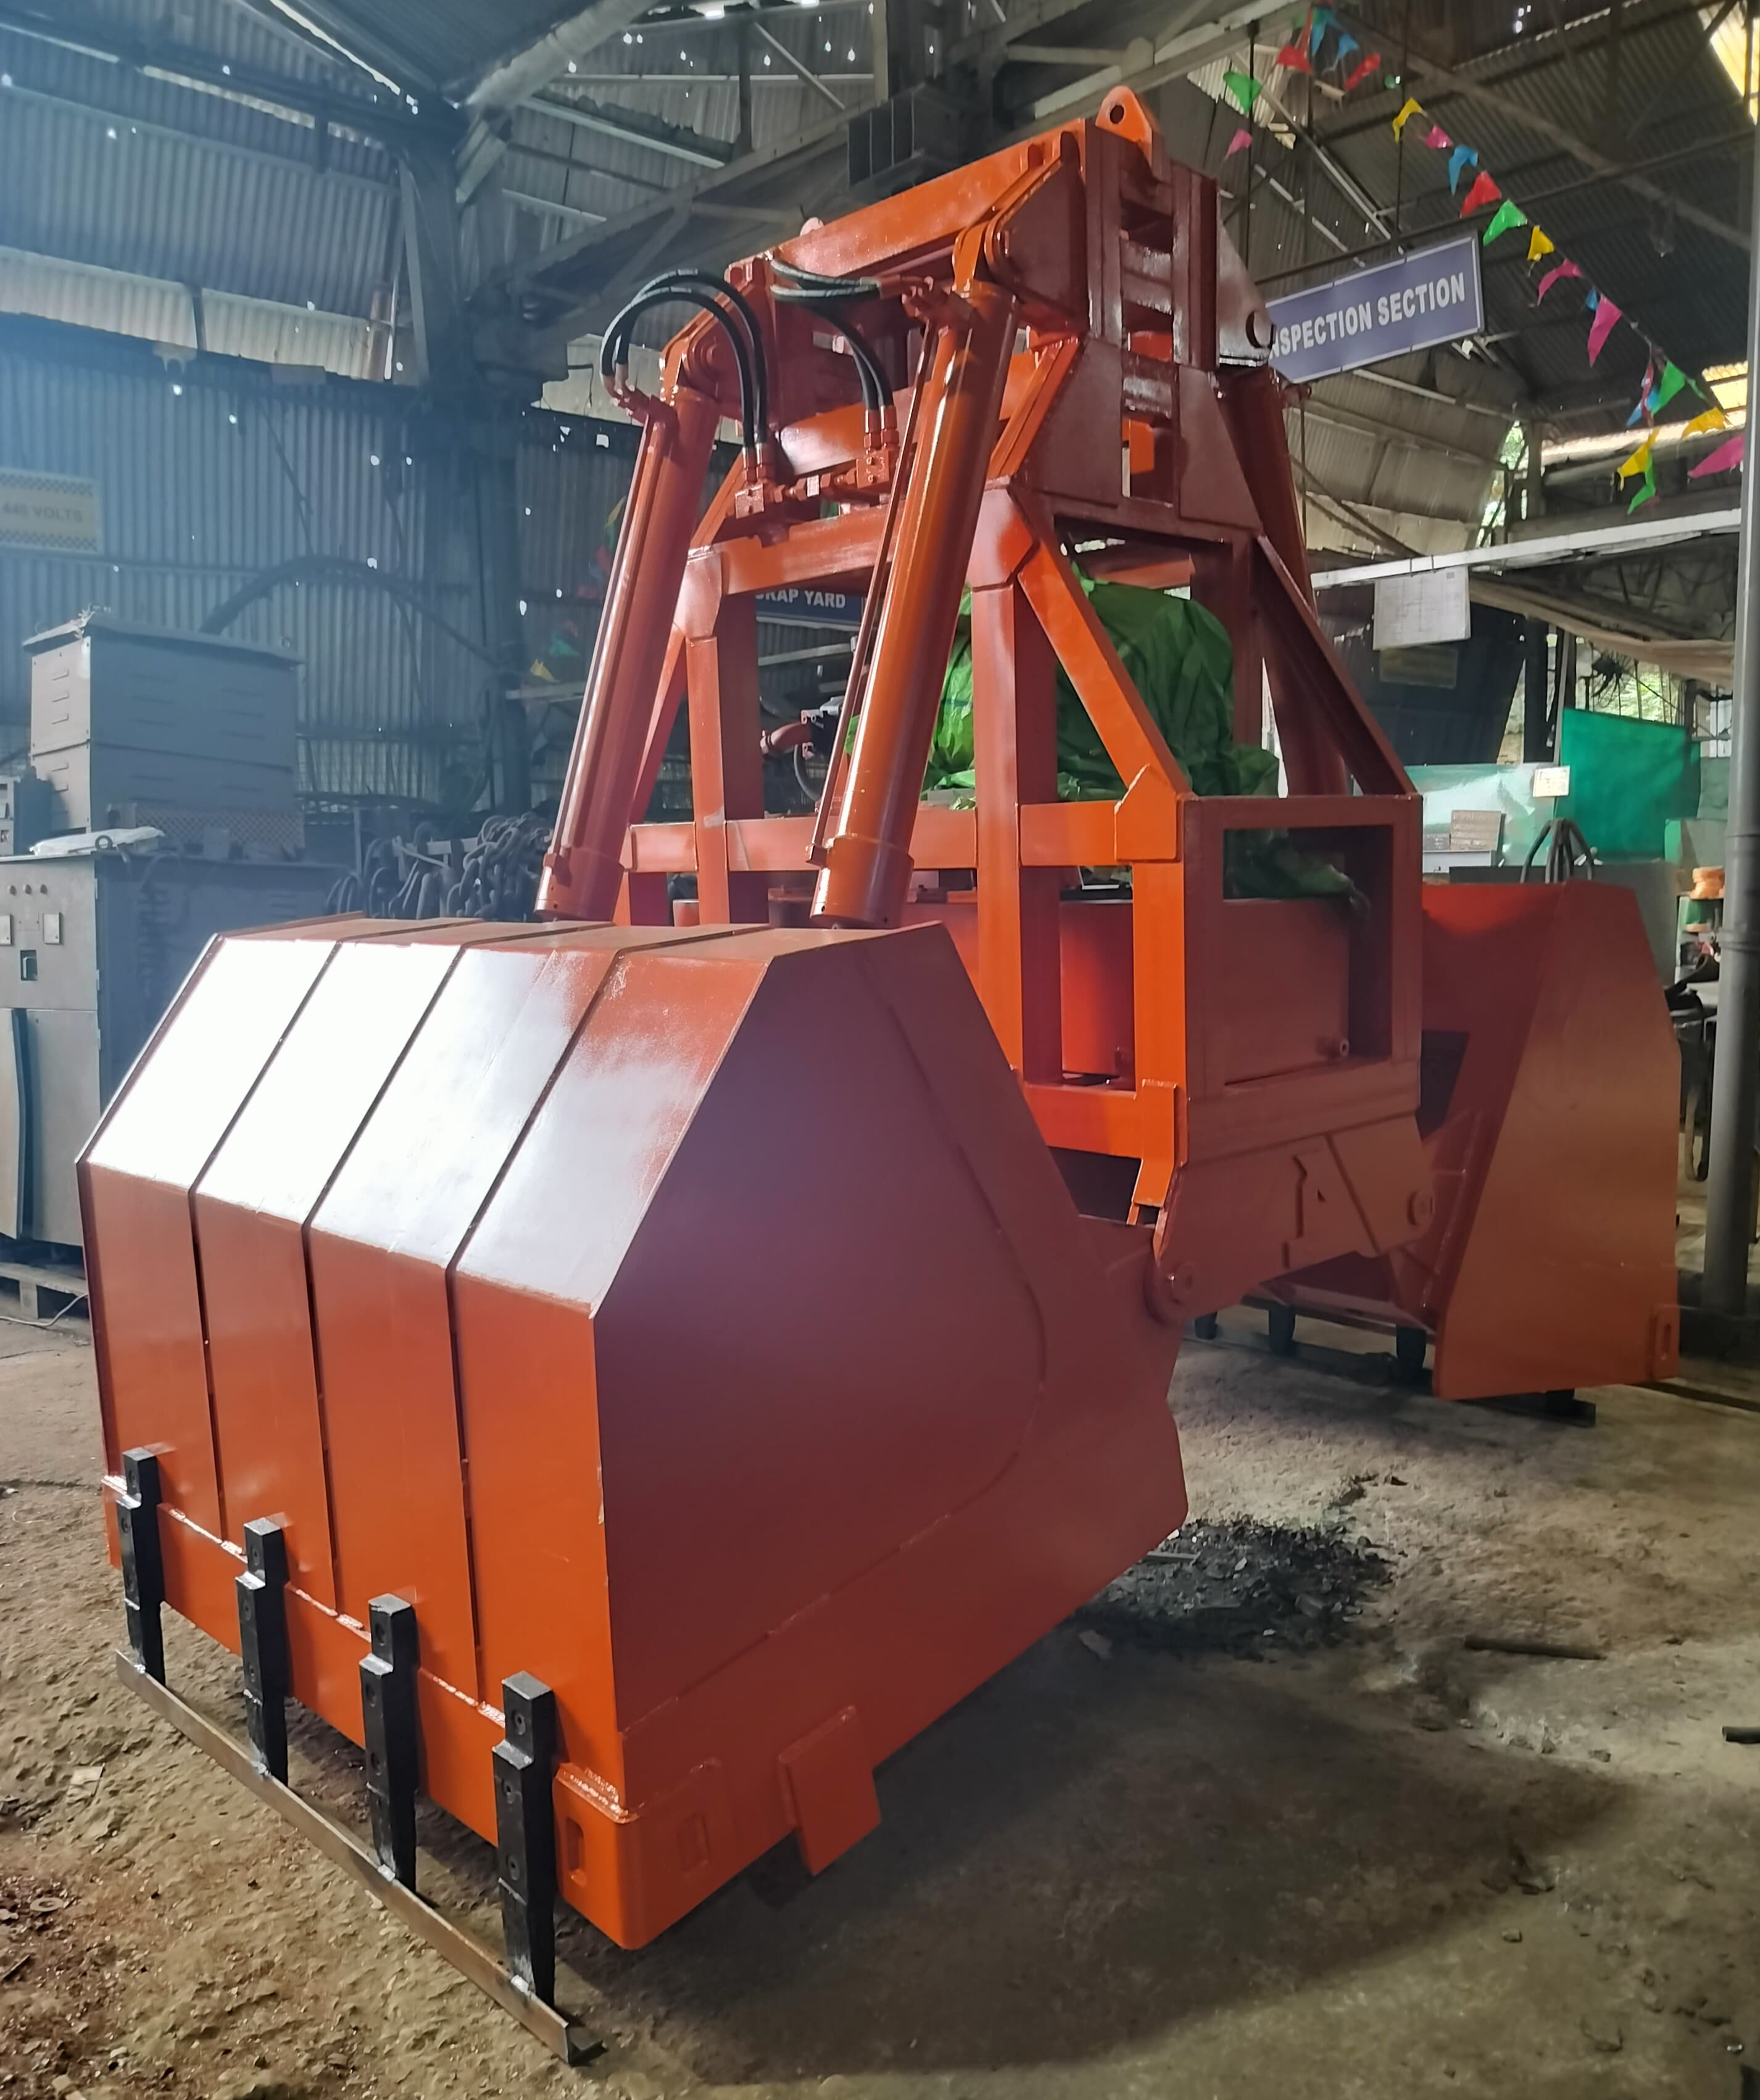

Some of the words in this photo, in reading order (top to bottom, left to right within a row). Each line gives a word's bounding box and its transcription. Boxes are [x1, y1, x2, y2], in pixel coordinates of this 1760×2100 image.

[1269, 301, 1372, 360] NSPECTION
[1377, 272, 1466, 326] SECTION
[755, 588, 799, 603] RAP
[804, 590, 846, 608] YARD
